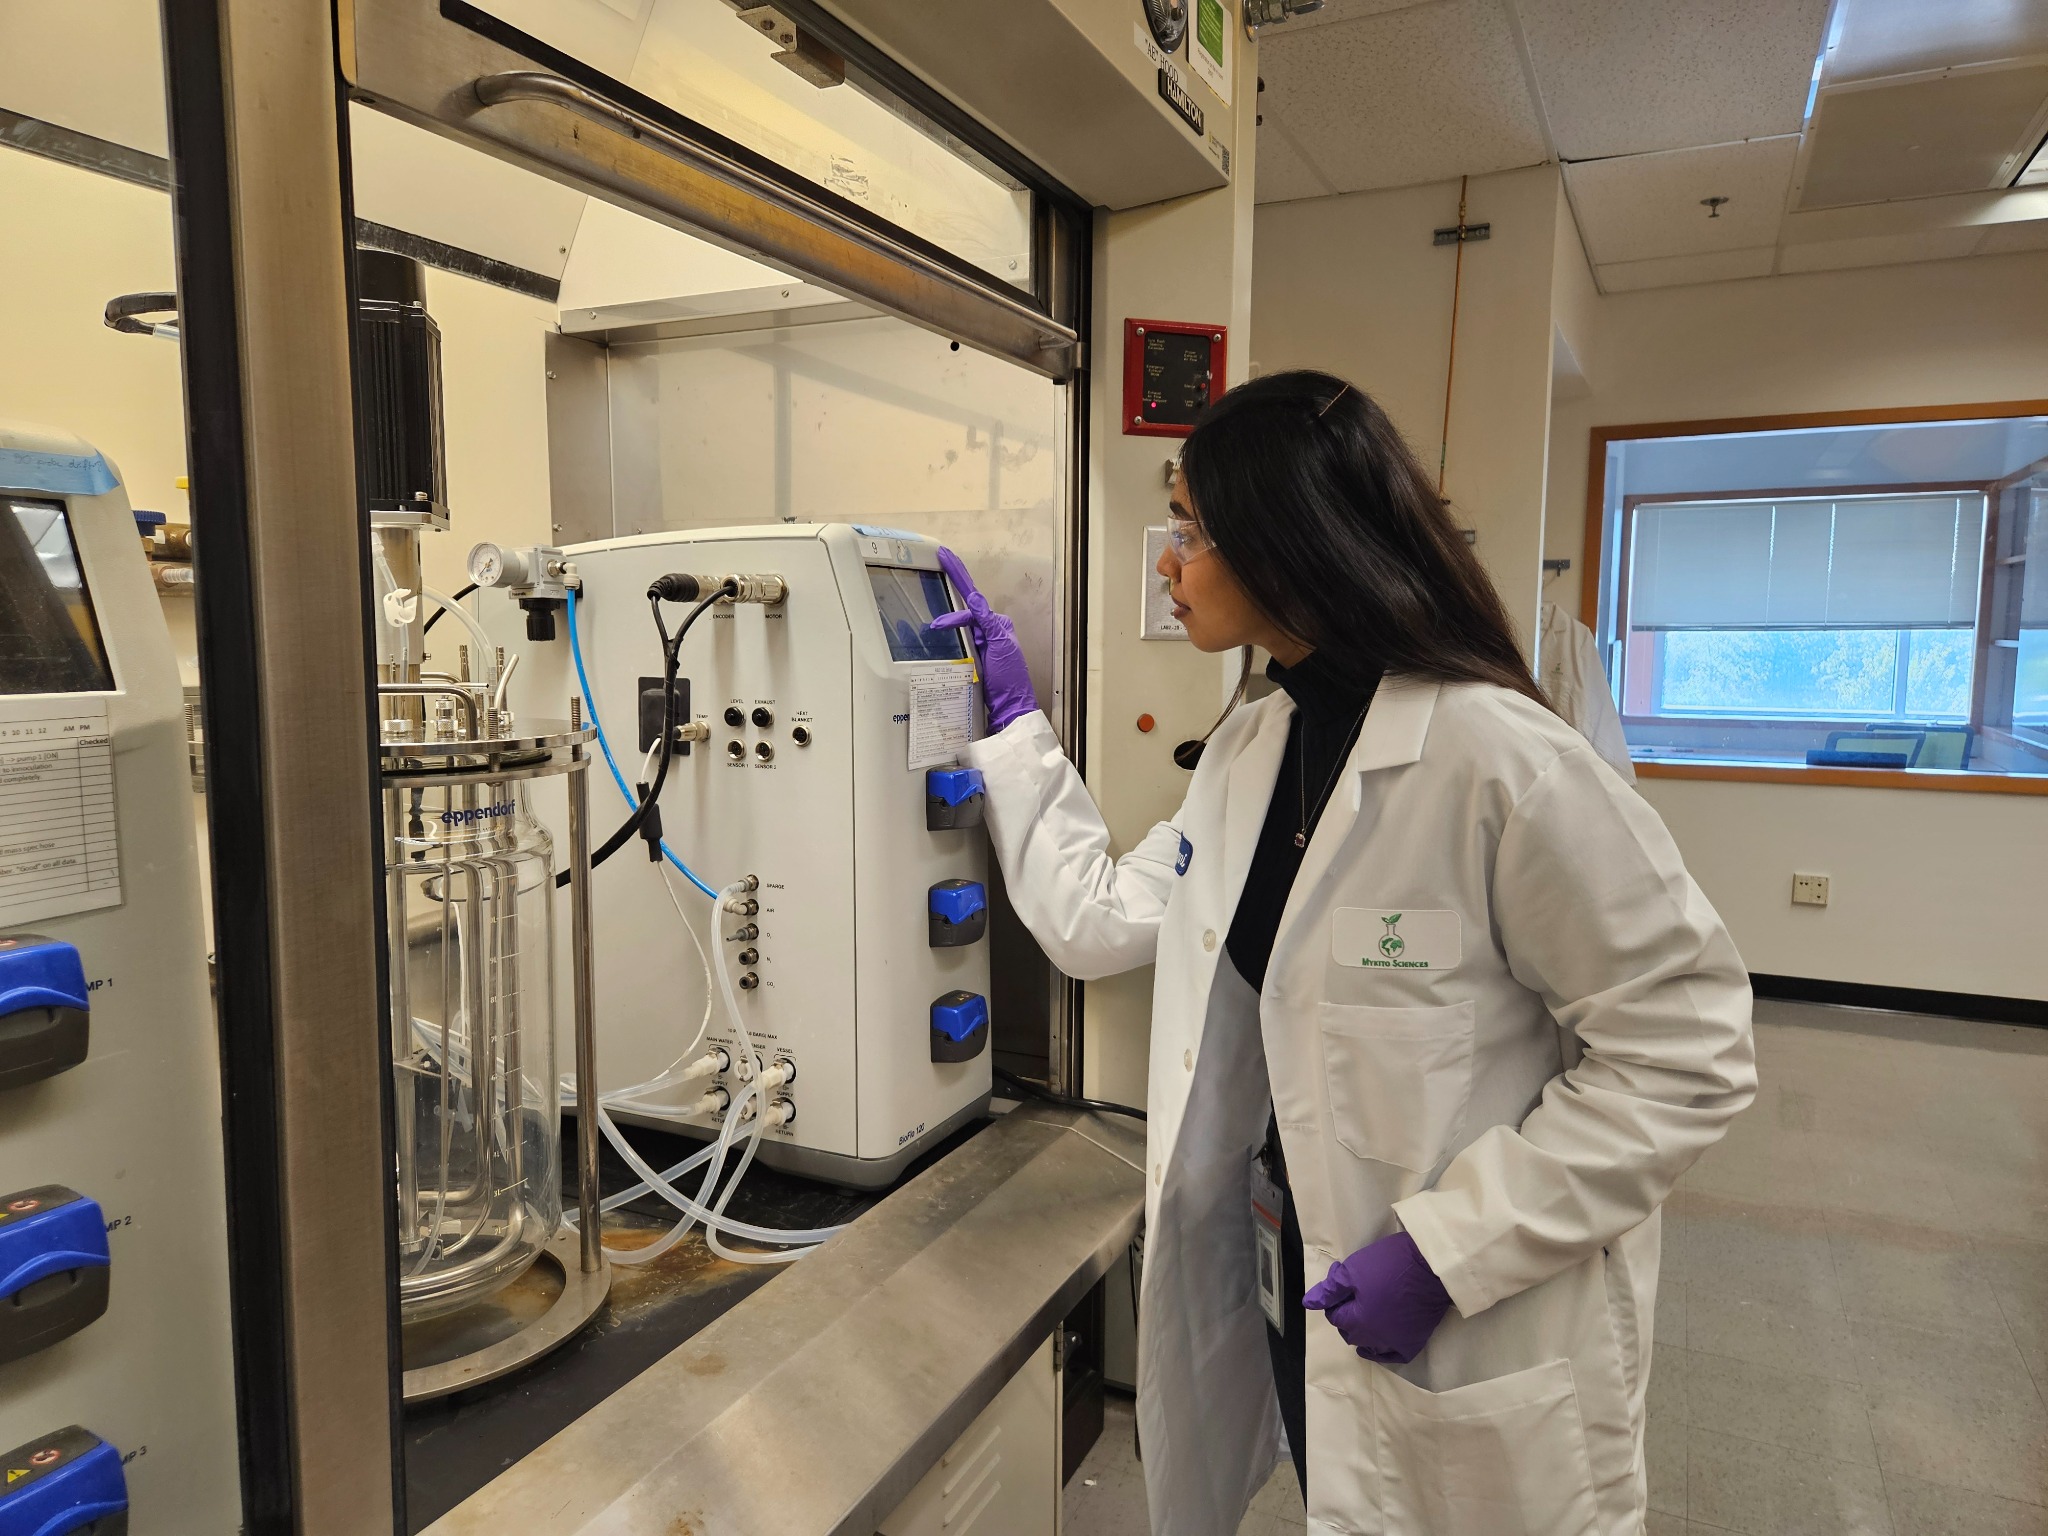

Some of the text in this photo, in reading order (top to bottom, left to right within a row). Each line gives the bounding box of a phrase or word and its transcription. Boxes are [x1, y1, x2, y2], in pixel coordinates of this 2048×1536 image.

[1160, 53, 1178, 83] HOOD
[1167, 76, 1201, 128] HAMILTON
[871, 541, 878, 555] 9
[79, 737, 108, 746] Checked
[16, 756, 37, 764] pump
[441, 799, 516, 826] eppendorf
[86, 978, 113, 991] MP 1
[775, 1129, 794, 1137] RETURN
[898, 1122, 925, 1146] BioFlo 120
[105, 1215, 132, 1233] MP 2
[139, 1445, 148, 1456] 3
